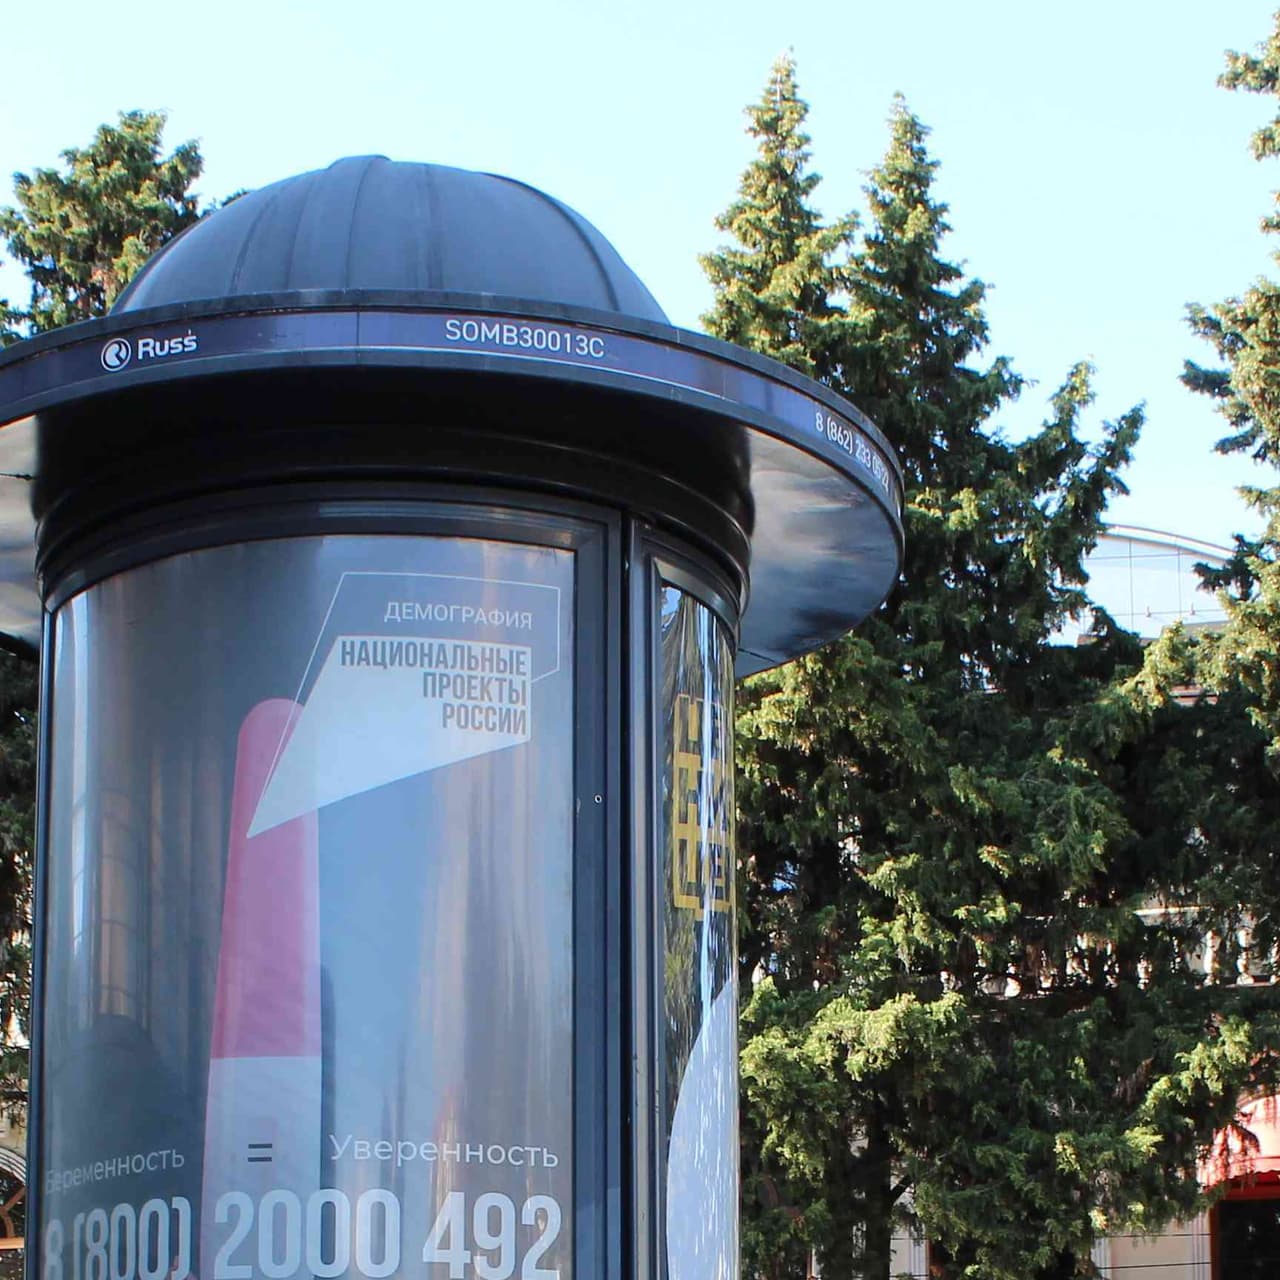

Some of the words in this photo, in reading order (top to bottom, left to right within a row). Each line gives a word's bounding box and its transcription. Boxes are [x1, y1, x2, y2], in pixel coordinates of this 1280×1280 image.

[445, 319, 604, 358] SOMB30013C
[815, 412, 824, 432] 8
[826, 416, 853, 454] (862)
[384, 602, 533, 629] ДЕМОГРАФИЯ
[341, 641, 527, 676] НАЦИОНАЛЬНЫЕ
[423, 672, 527, 706] ПРОЕКТЫ
[442, 703, 526, 735] РОССИИ
[45, 1149, 185, 1195] Беременность
[329, 1134, 559, 1167] Уверенность
[214, 1189, 401, 1280] 2000
